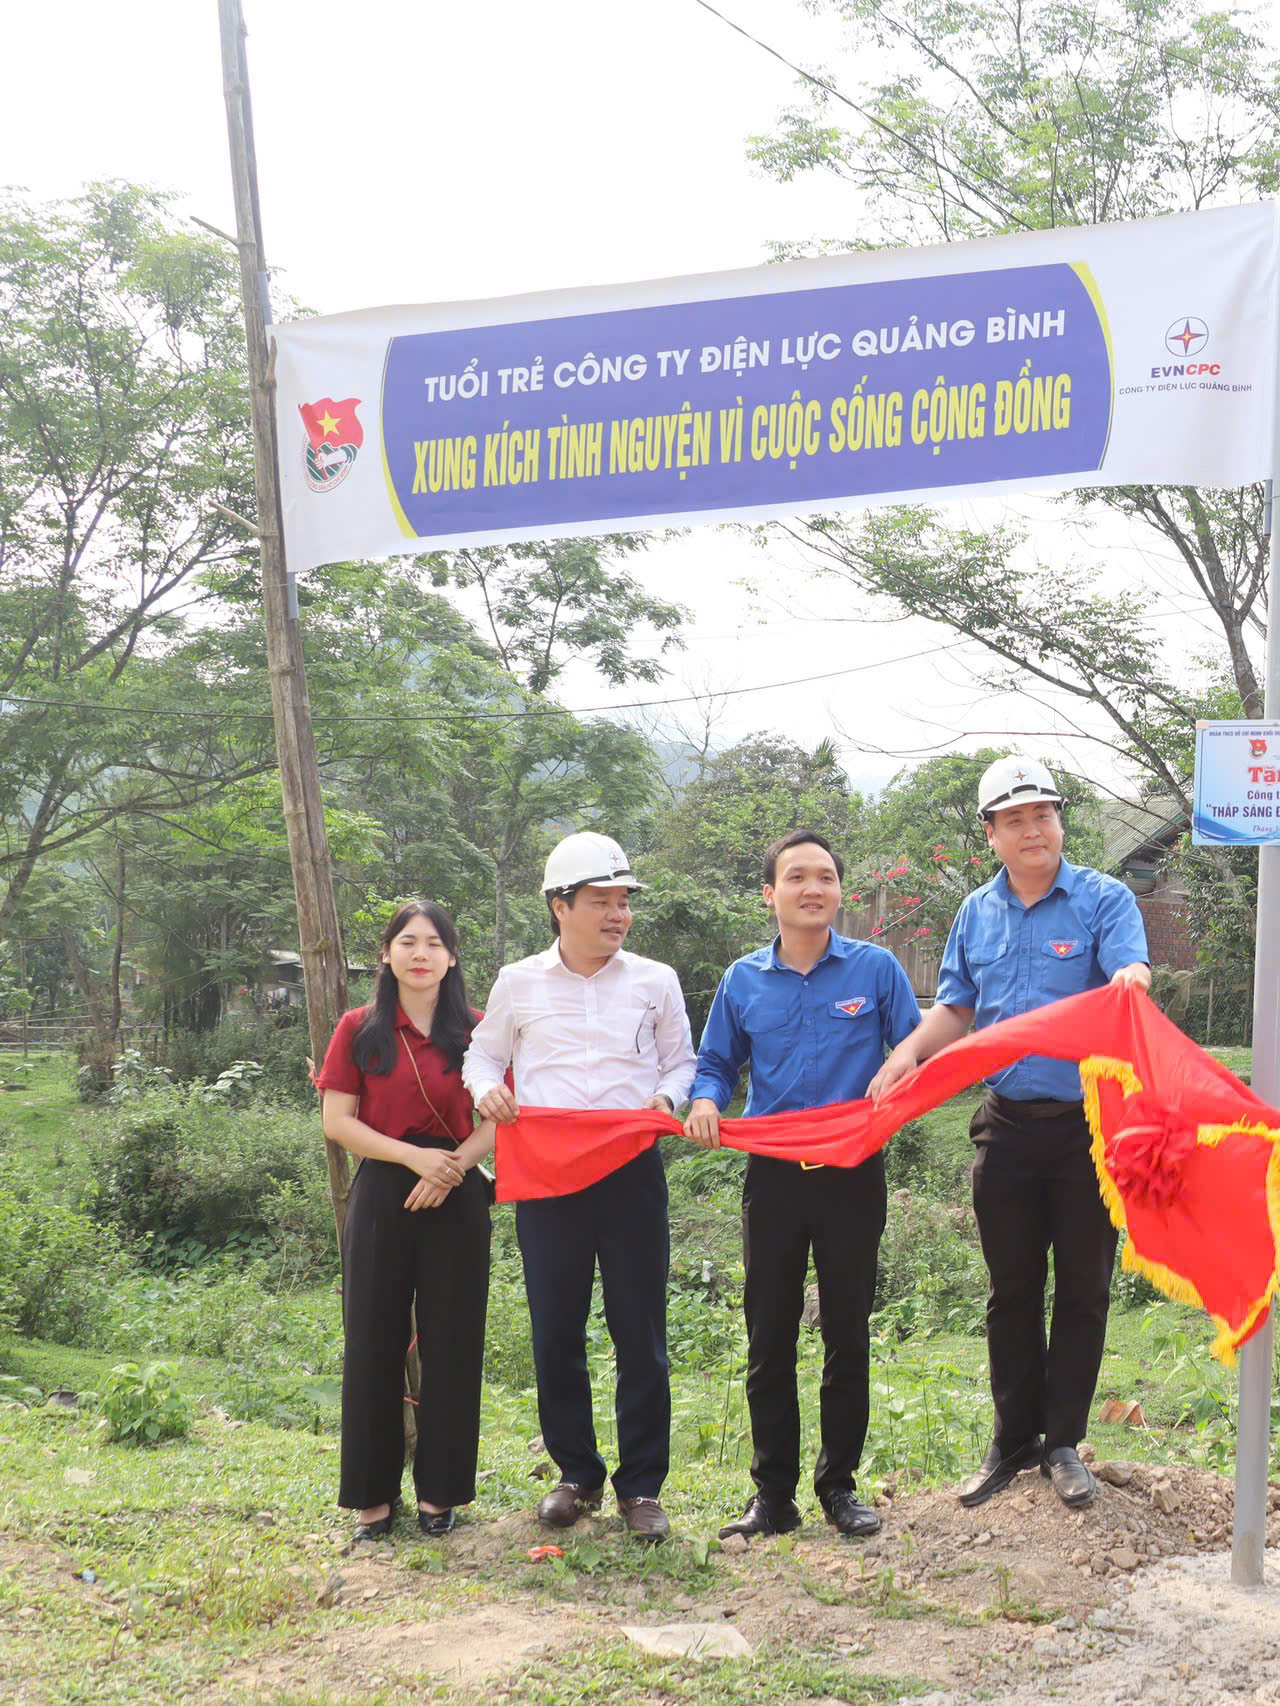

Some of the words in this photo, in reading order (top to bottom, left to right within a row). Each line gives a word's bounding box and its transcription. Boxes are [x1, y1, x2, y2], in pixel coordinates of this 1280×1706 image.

[424, 358, 489, 402] TUỔI
[498, 356, 544, 394] TRẺ
[553, 352, 648, 389] CÔNG
[657, 349, 691, 377] TY
[700, 336, 770, 377] ĐIỆN
[781, 331, 842, 370] LỰC
[852, 315, 976, 357] QUẢNG
[986, 306, 1065, 343] BÌNH
[1151, 363, 1221, 378] EVNCPC
[1119, 386, 1143, 395] CÔNG
[1179, 381, 1197, 390] LỰC
[1199, 381, 1230, 392] QUẢNG
[1232, 383, 1252, 392] BÌNH
[412, 435, 477, 494] XUNG
[483, 420, 541, 487] KÍCH
[547, 414, 603, 481] TÌNH
[609, 401, 712, 480] NGUYỆN
[720, 395, 744, 464] VÌ
[751, 390, 822, 470] CUỘC
[829, 375, 903, 453] SỐNG
[911, 375, 986, 456] CỘNG
[994, 358, 1072, 436] ĐỒNG
[1247, 790, 1273, 801] Công
[1242, 804, 1272, 818] SÁNG
